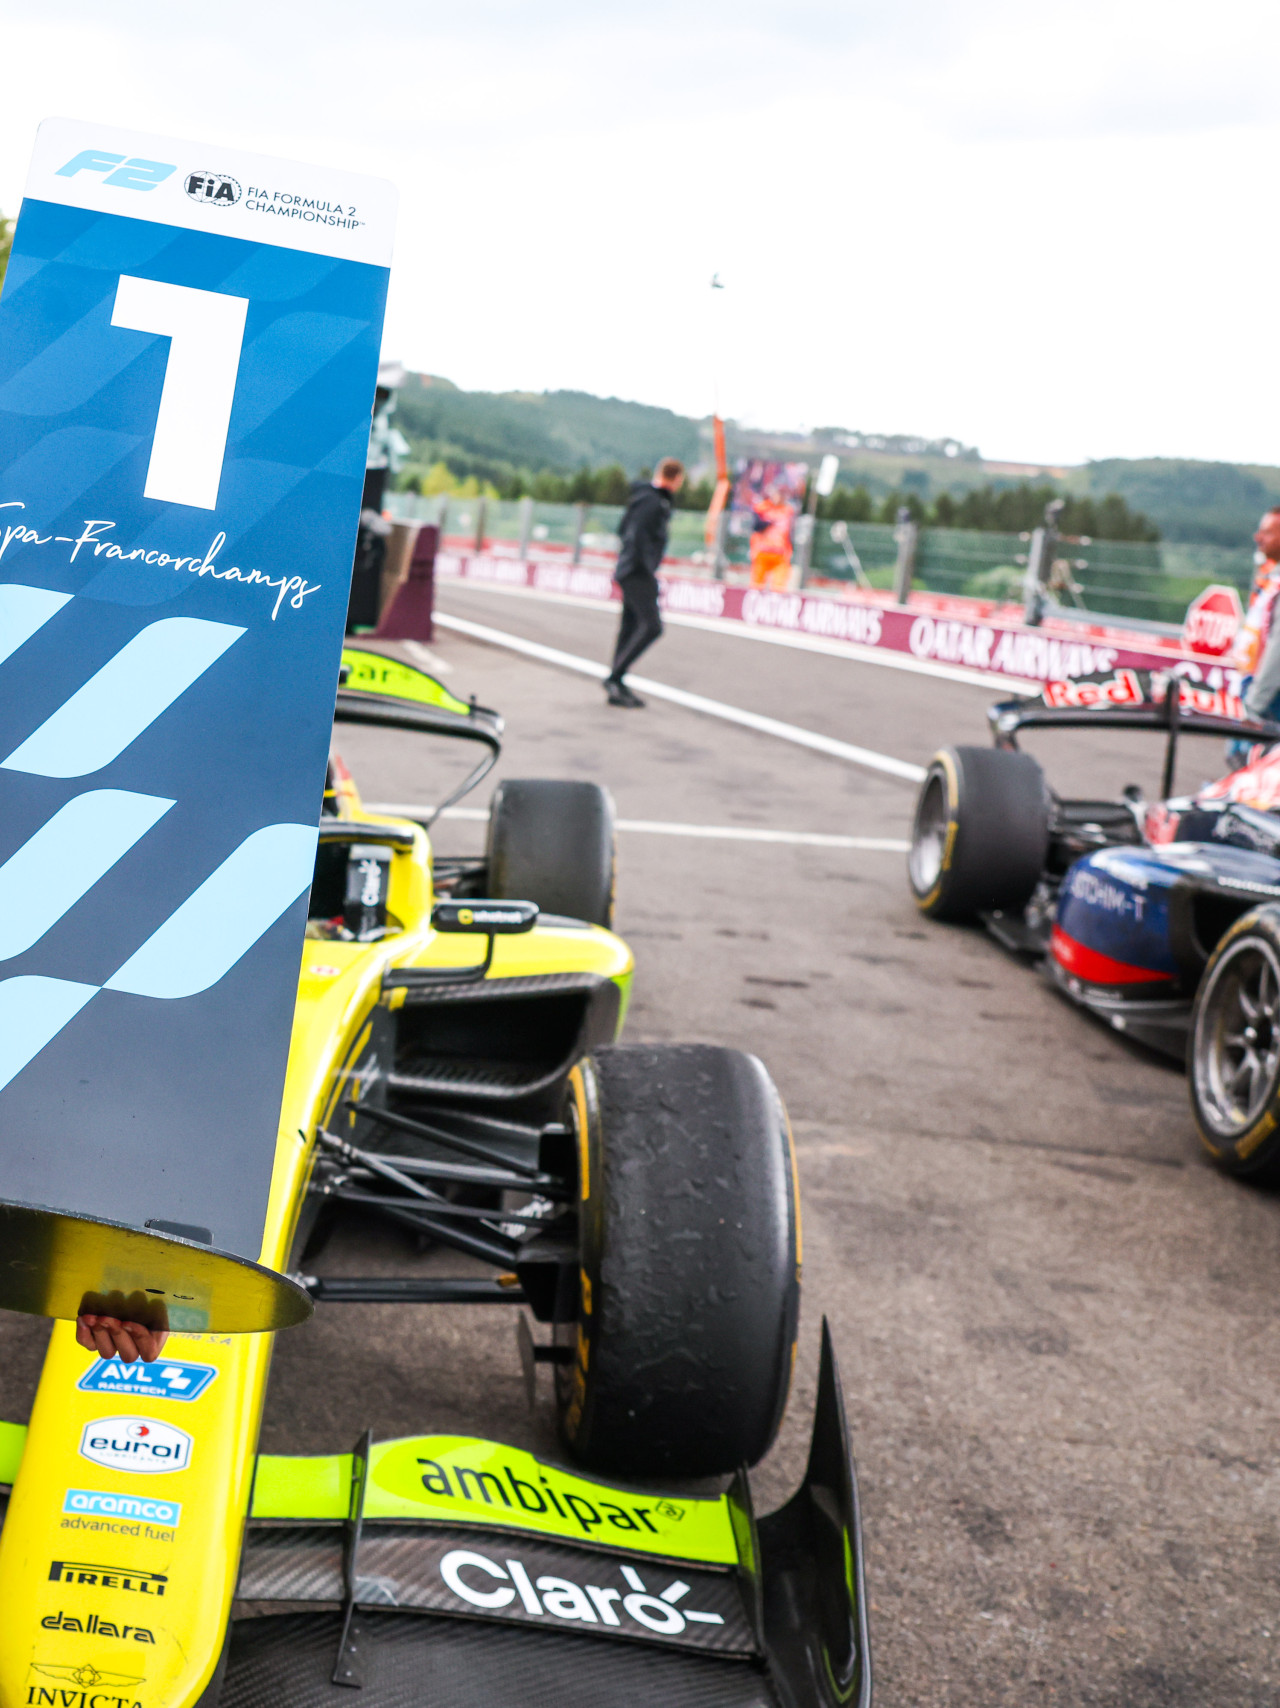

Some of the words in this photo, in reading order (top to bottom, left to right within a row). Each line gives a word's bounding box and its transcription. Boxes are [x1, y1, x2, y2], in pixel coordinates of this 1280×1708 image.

[54, 149, 178, 192] F2
[247, 186, 269, 200] FIA
[273, 191, 344, 215] FORMULA
[348, 206, 357, 217] 2
[109, 273, 251, 512] 1
[909, 616, 995, 669] QATAR
[1042, 669, 1148, 707] Red
[97, 1381, 167, 1396] RACETECH
[101, 1362, 153, 1383] AVL
[90, 1437, 181, 1459] eurol
[70, 1494, 173, 1521] aramco
[416, 1457, 660, 1535] ambipar
[60, 1517, 141, 1537] advanced
[145, 1525, 176, 1543] fuel
[47, 1560, 169, 1597] PIRELLI
[438, 1548, 725, 1635] Claro
[40, 1611, 156, 1645] dallara
